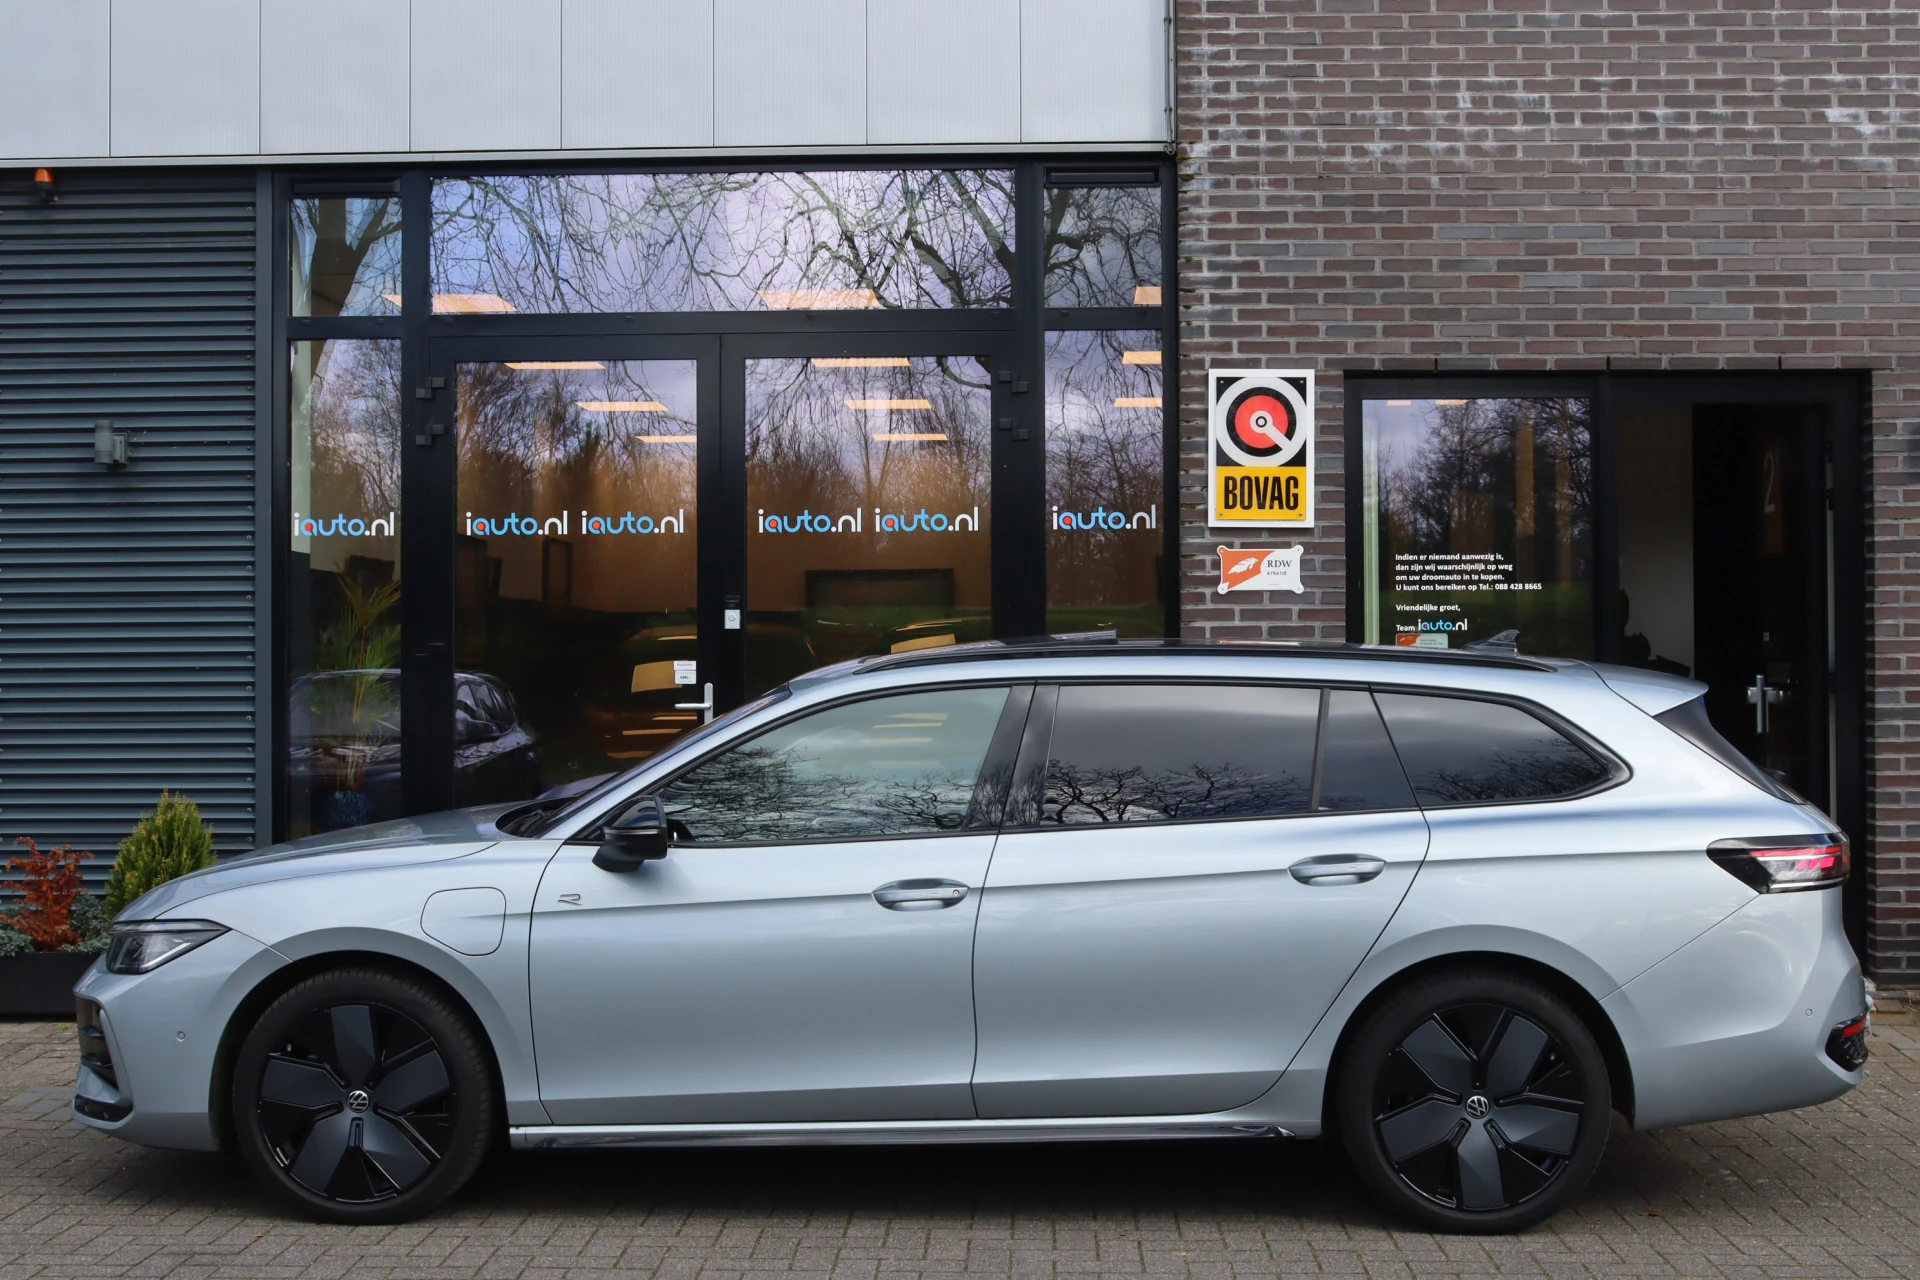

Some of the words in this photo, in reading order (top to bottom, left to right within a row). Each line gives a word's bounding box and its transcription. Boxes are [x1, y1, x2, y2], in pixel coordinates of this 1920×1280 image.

[1223, 475, 1299, 511] BOVAG
[466, 510, 568, 536] iauto.nl
[582, 509, 684, 535] iauto.nl
[758, 507, 862, 533] iauto.nl
[875, 506, 979, 532] iauto.nl
[1052, 504, 1157, 530] iauto.nl
[293, 511, 395, 537] iauto.nl
[1395, 553, 1418, 561] Indien
[1428, 553, 1460, 561] niemand
[1461, 553, 1495, 562] aanwezig
[1495, 552, 1504, 561] is,
[1267, 559, 1292, 568] RDW
[1395, 563, 1409, 571] dan
[1410, 563, 1423, 572] zijn
[1424, 563, 1436, 572] wij
[1437, 562, 1486, 572] waarschijnlijk
[1486, 564, 1497, 572] op
[1498, 564, 1513, 572] weg
[1421, 573, 1462, 581] droomauto
[1480, 573, 1505, 581] kopen.
[1395, 583, 1402, 591] U
[1403, 583, 1419, 591] kunt
[1435, 583, 1466, 591] bereiken
[1467, 584, 1478, 592] op
[1479, 583, 1494, 591] Tel.:
[1395, 604, 1438, 612] Vriendelijke
[1439, 604, 1461, 612] groet,
[1395, 624, 1416, 632] Team
[1417, 618, 1468, 631] iauto.nl
